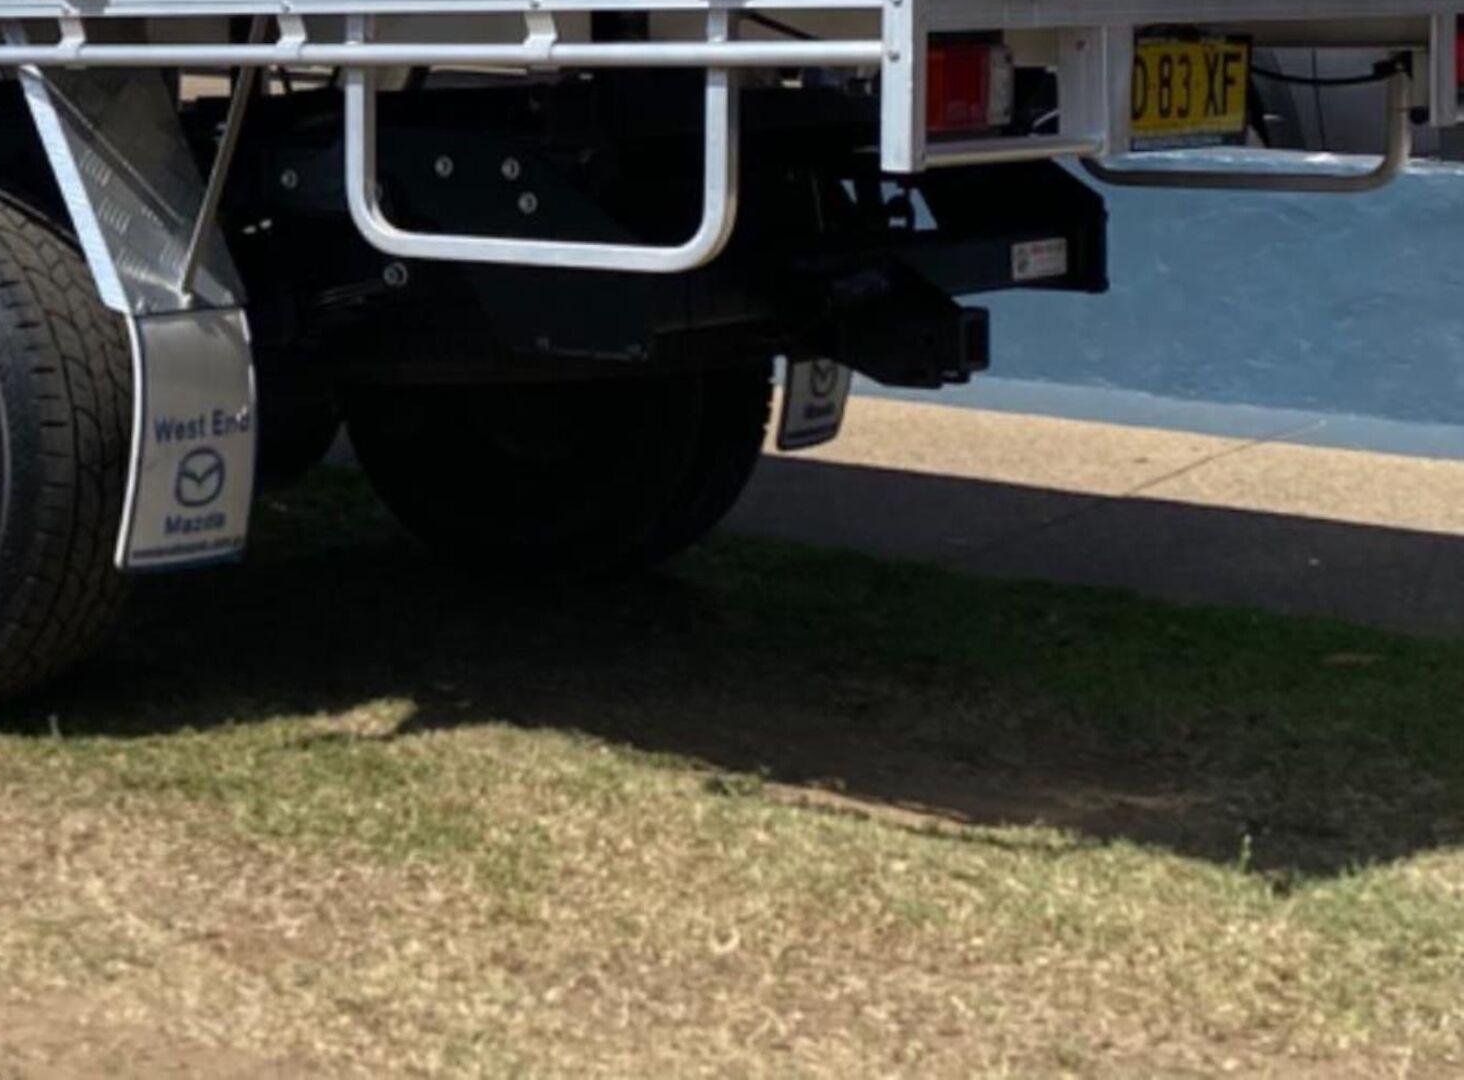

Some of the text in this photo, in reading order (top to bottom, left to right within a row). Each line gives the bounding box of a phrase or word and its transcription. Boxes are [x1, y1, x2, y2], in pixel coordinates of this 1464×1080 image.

[1158, 53, 1193, 119] 83
[1203, 52, 1242, 118] XF
[154, 409, 250, 443] West End
[165, 514, 226, 534] Mazda
